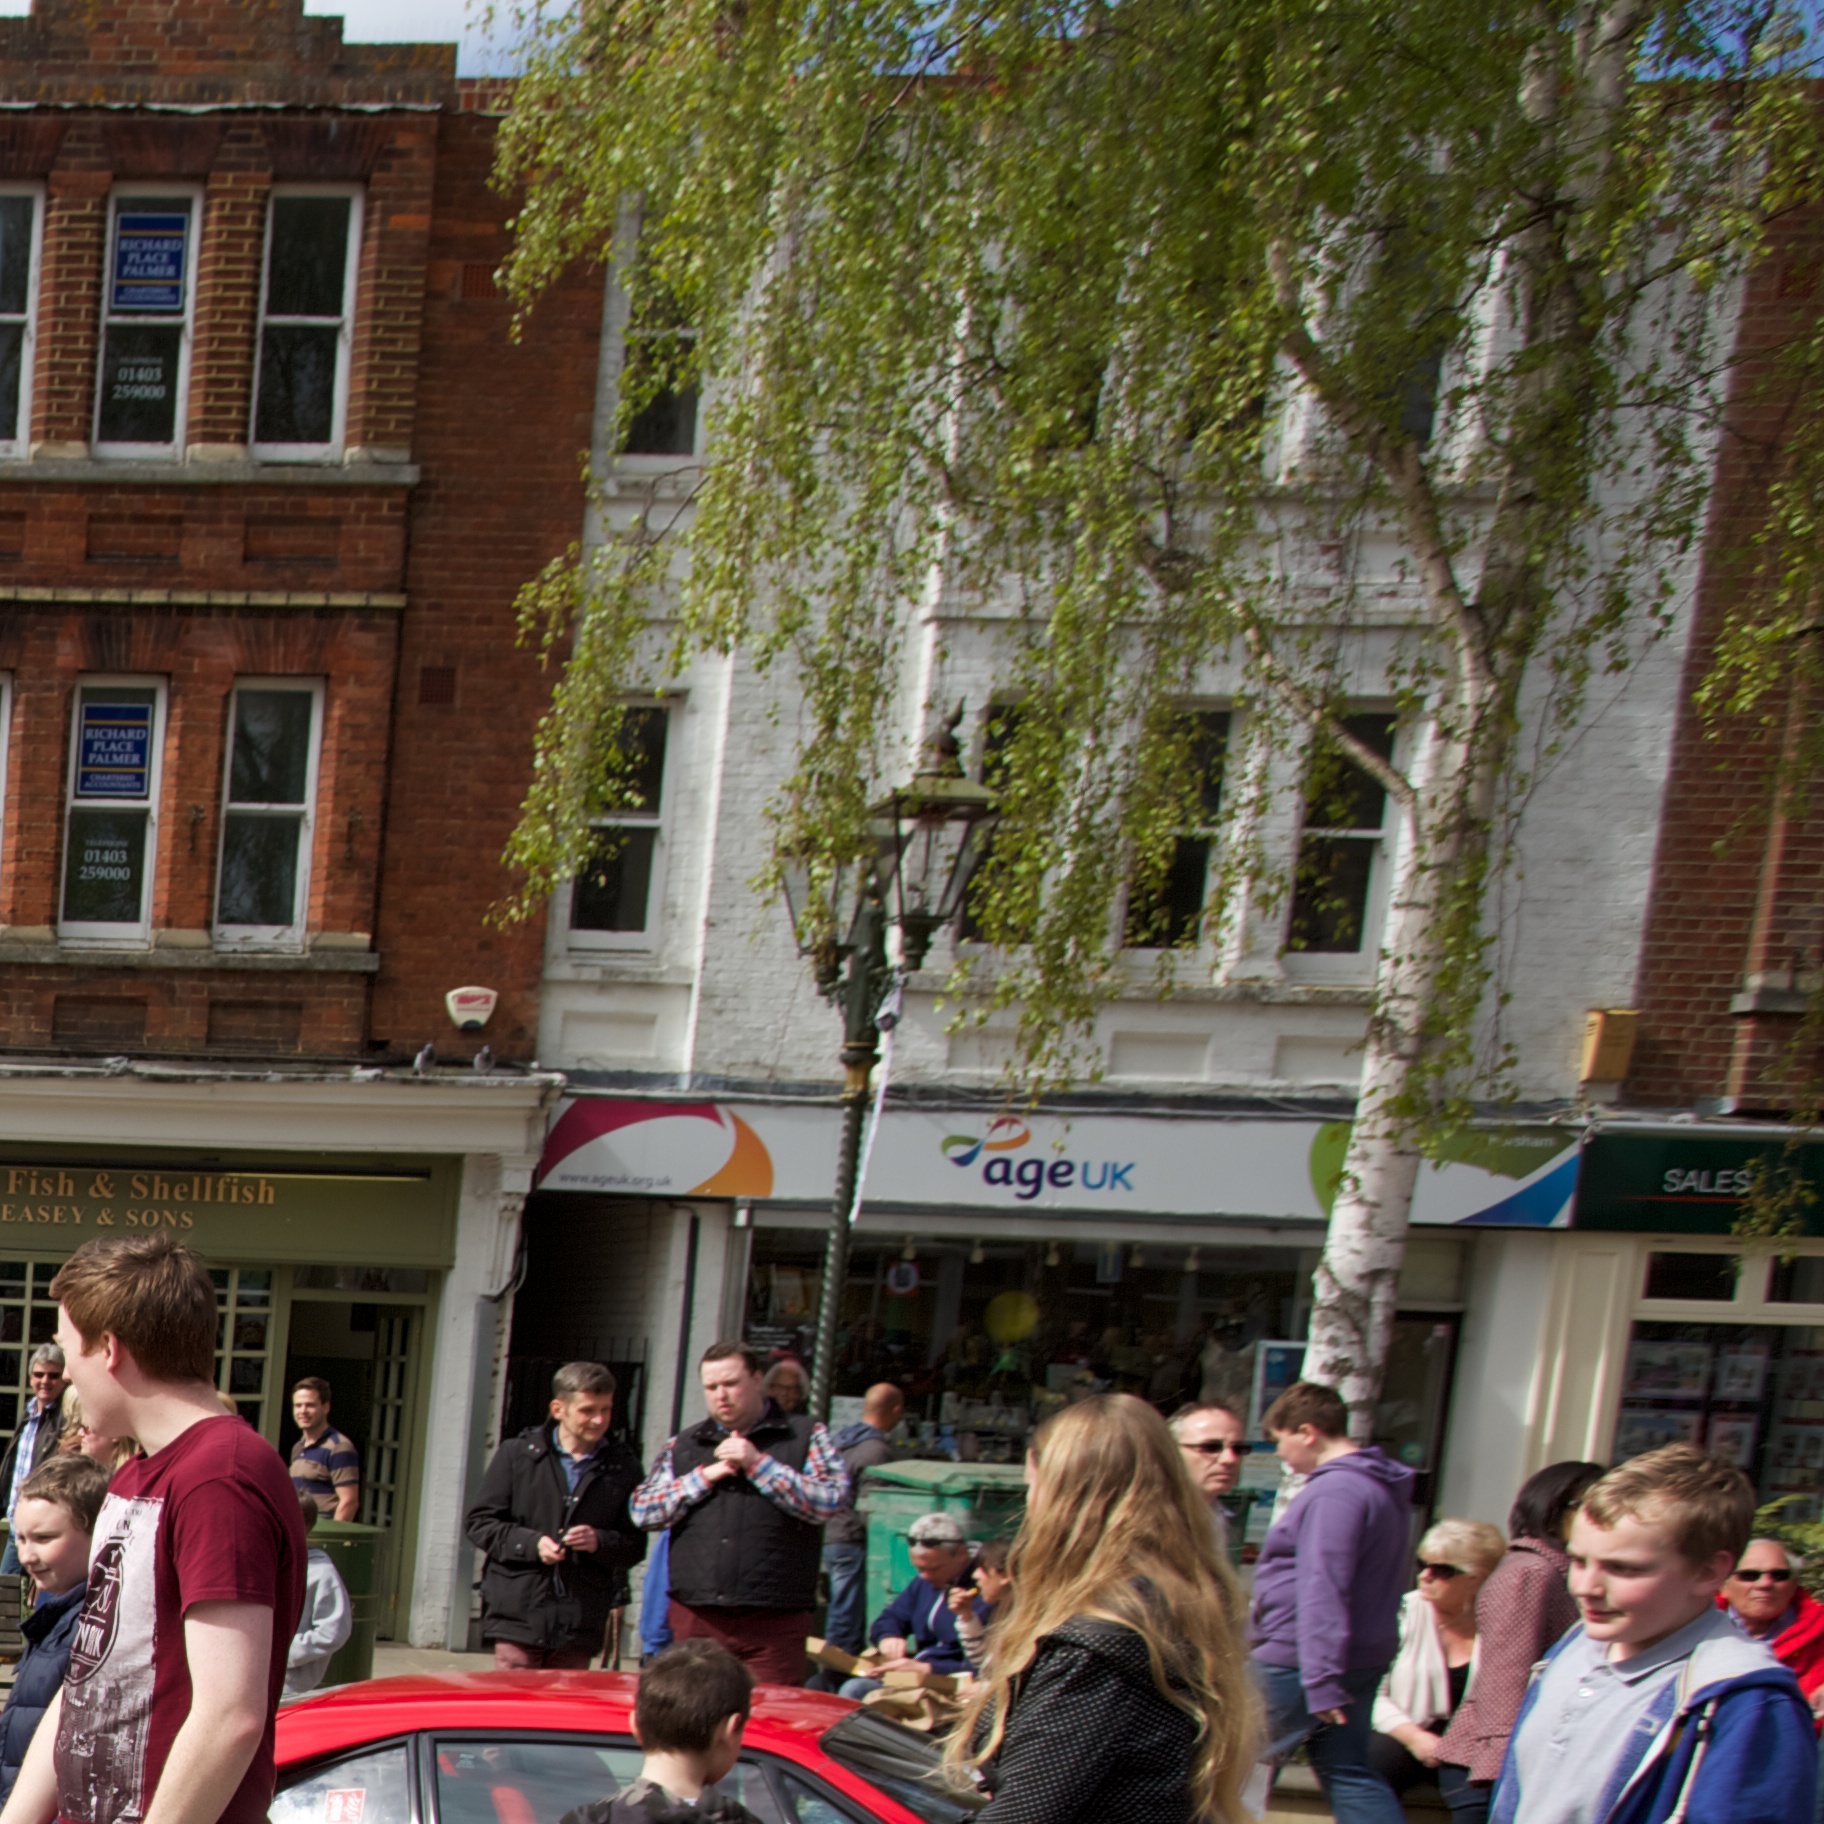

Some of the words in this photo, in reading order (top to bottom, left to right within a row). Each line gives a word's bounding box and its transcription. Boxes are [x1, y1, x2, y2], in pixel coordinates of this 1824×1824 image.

[120, 239, 182, 251] RICHARD
[127, 252, 168, 263] PLACE
[122, 265, 176, 277] PALMER
[117, 367, 162, 381] 01403
[113, 385, 165, 399] 259000
[85, 728, 146, 740] RICHARD
[93, 741, 134, 752] PLACE
[88, 753, 140, 764] PALMER
[84, 849, 127, 863] 01403
[79, 866, 130, 880] 259000
[559, 1172, 672, 1188] www.ageuk.org.uk
[983, 1157, 1075, 1200] age
[1081, 1161, 1136, 1191] UK
[1663, 1168, 1751, 1194] SALES
[6, 1168, 75, 1197] Fish
[88, 1172, 116, 1199] &
[130, 1173, 275, 1204] Shellfish
[96, 1207, 116, 1226] &
[126, 1208, 194, 1229] SONS
